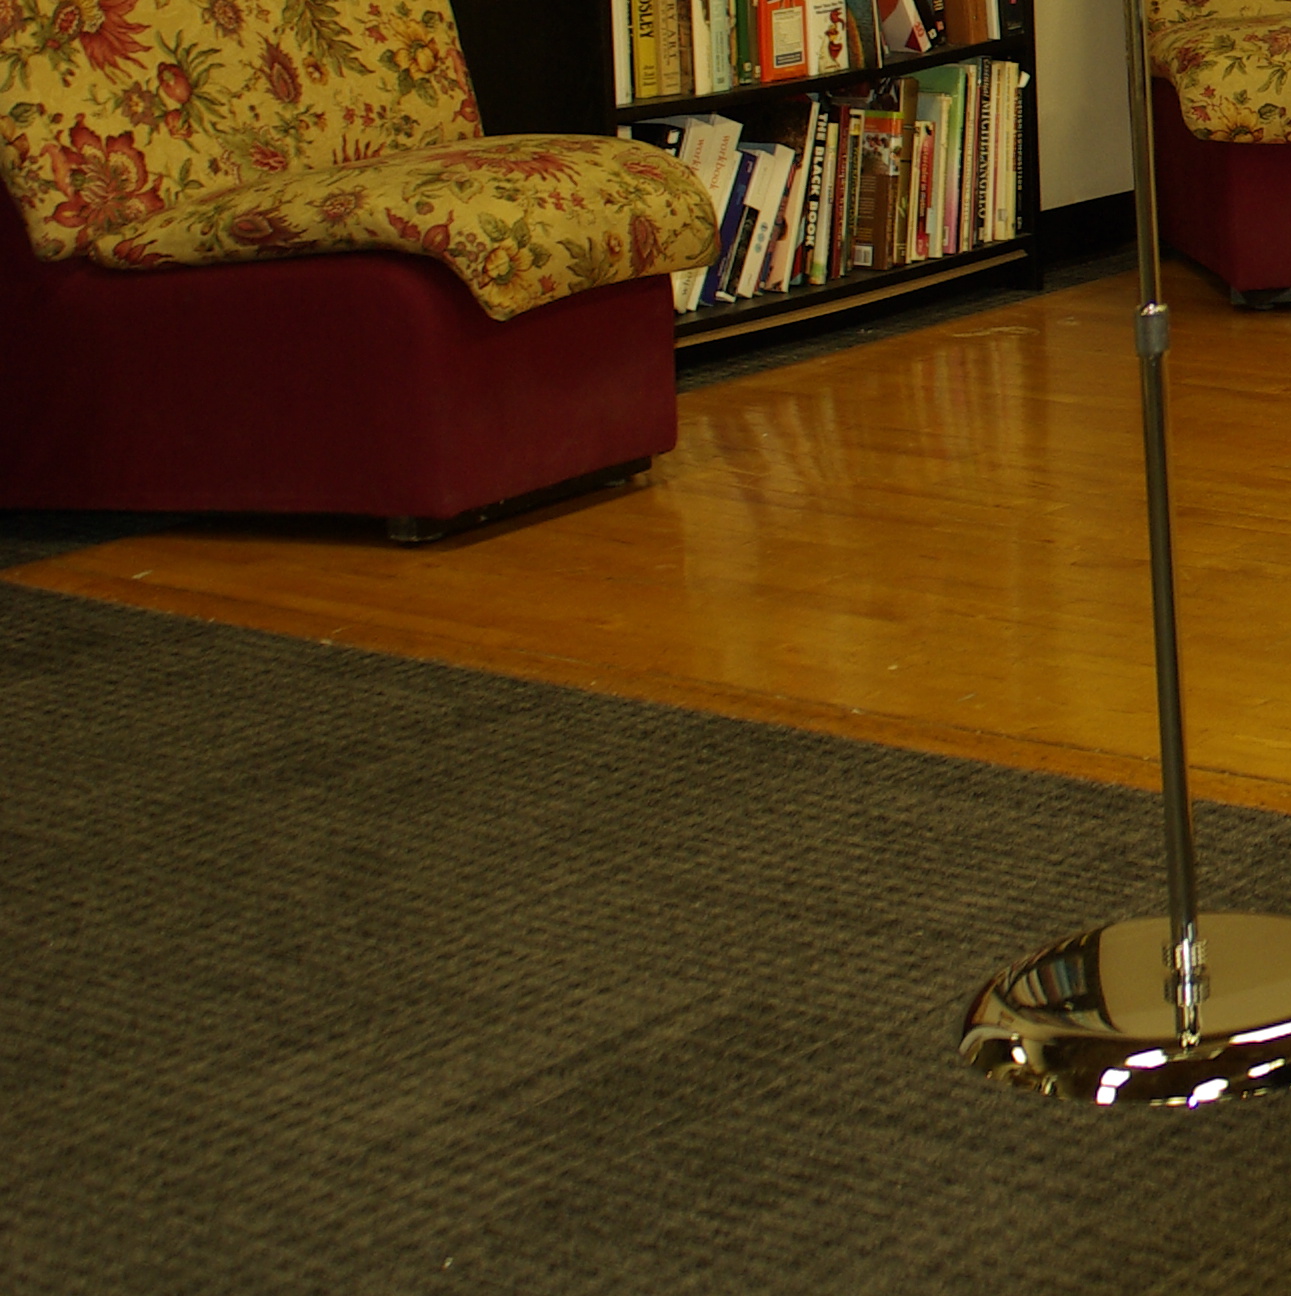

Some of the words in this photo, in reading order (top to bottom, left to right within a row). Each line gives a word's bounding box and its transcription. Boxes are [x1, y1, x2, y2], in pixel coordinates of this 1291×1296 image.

[667, 30, 677, 61] ART
[816, 113, 828, 141] THE
[709, 135, 731, 190] workbook
[810, 146, 824, 195] BLACK
[978, 100, 991, 219] MICHELANGELO
[805, 201, 819, 247] BOOK
